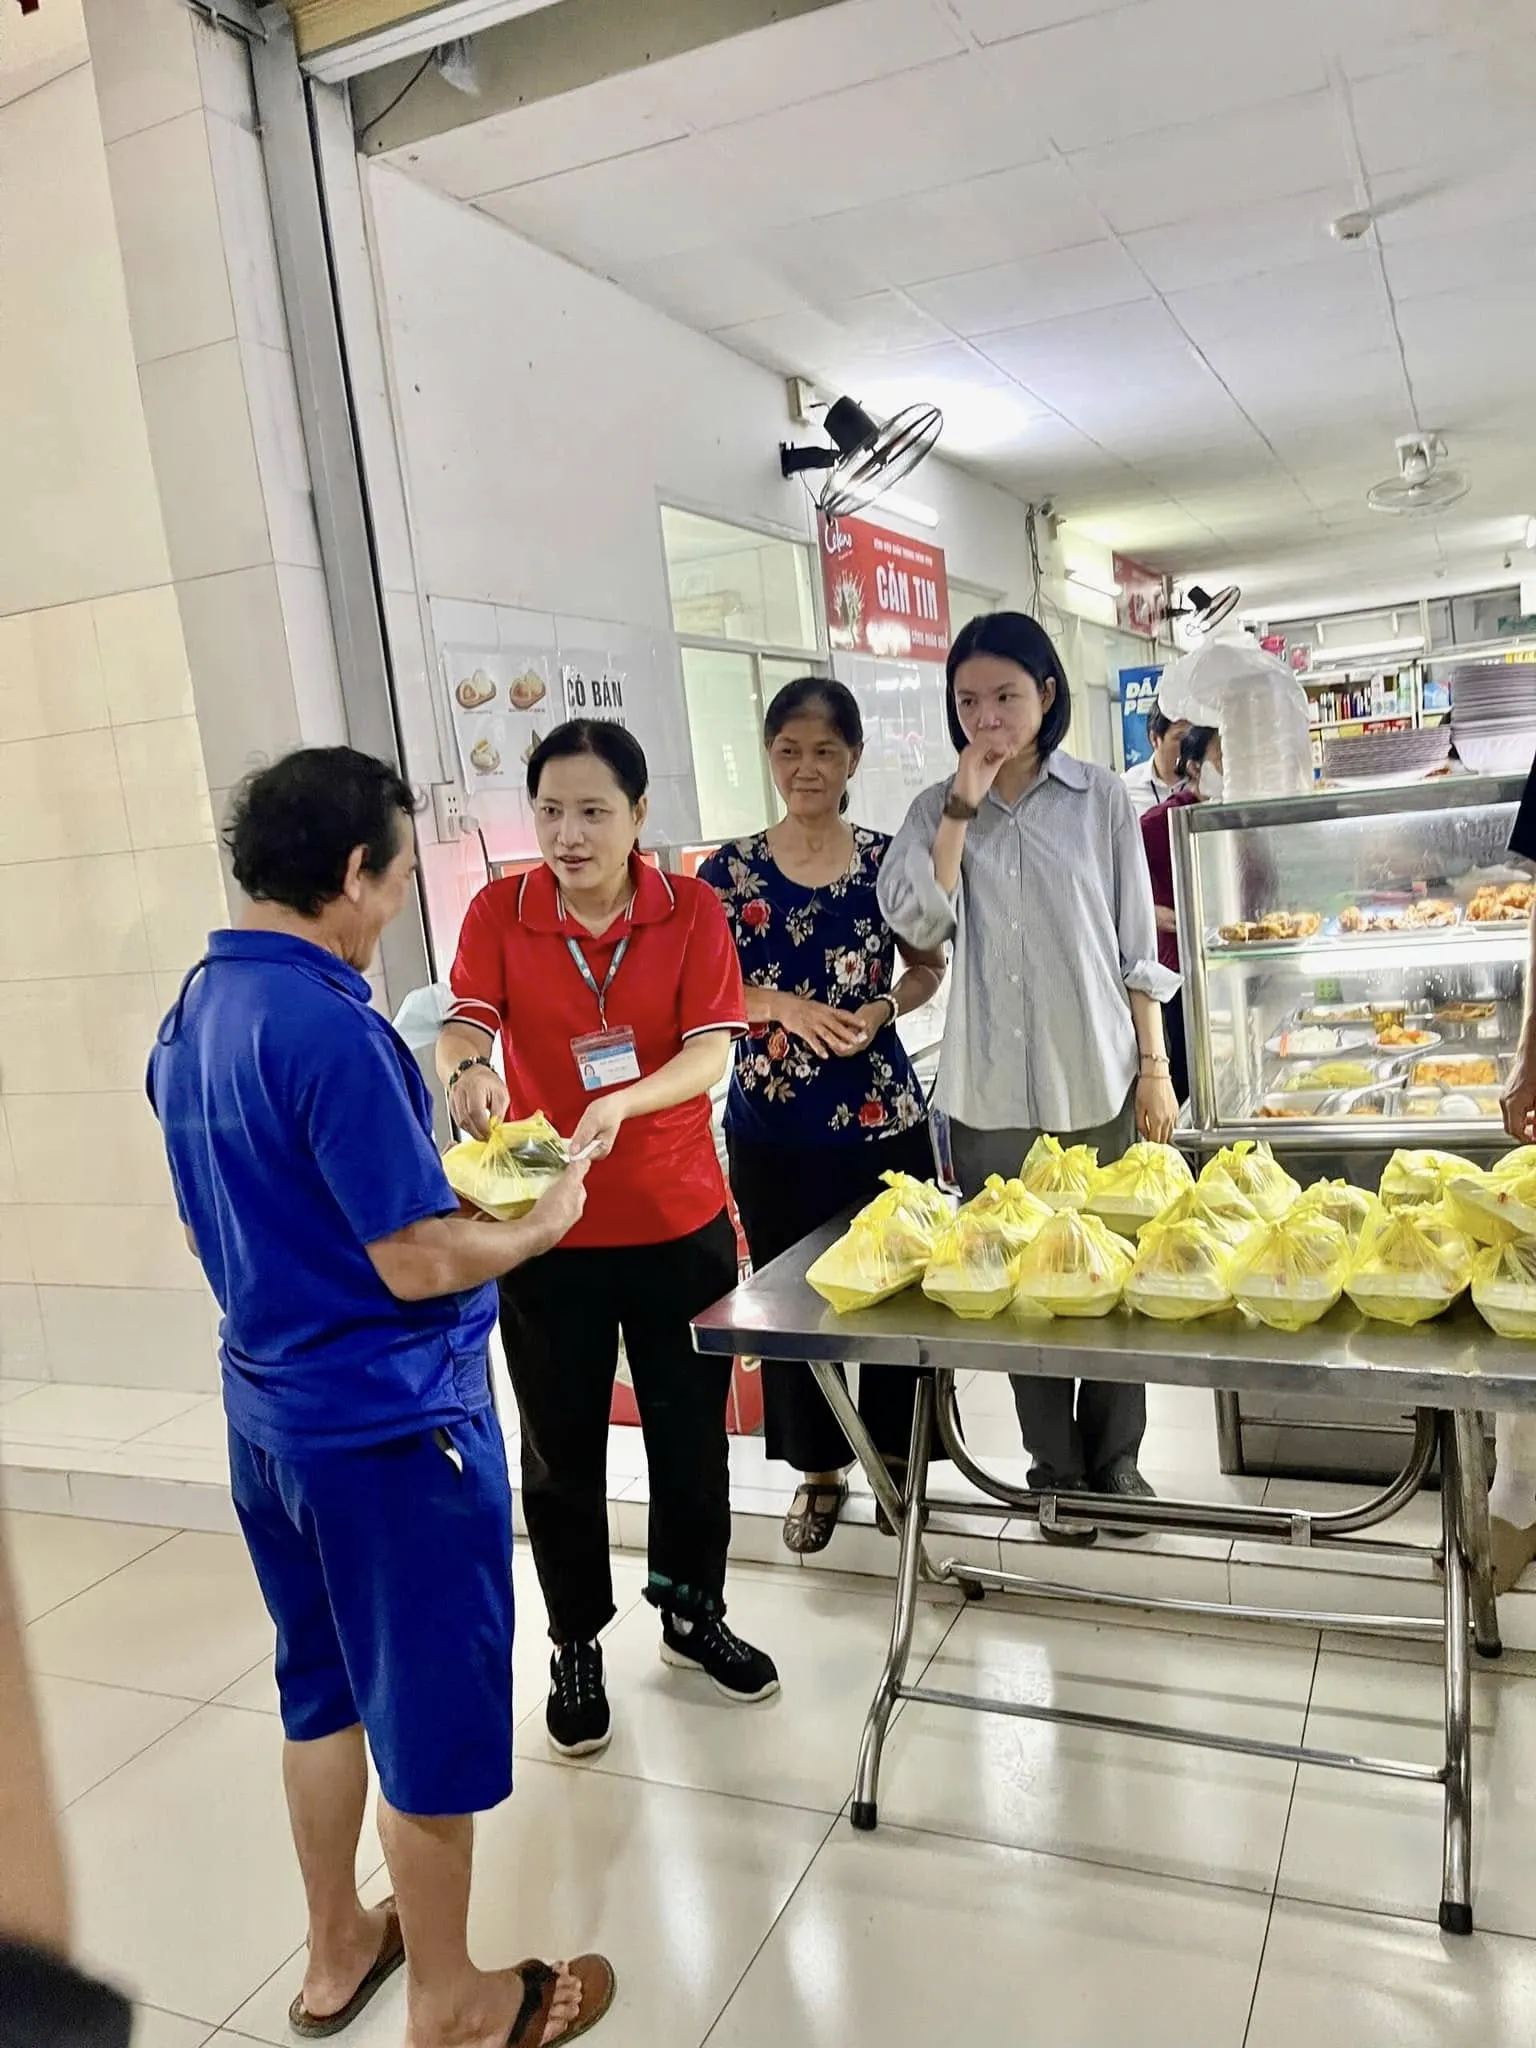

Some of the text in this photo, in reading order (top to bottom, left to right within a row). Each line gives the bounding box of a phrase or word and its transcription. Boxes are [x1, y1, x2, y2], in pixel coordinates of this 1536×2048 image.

[876, 561, 939, 622] CĂN TIN
[567, 674, 623, 708] CÓ BÁN
